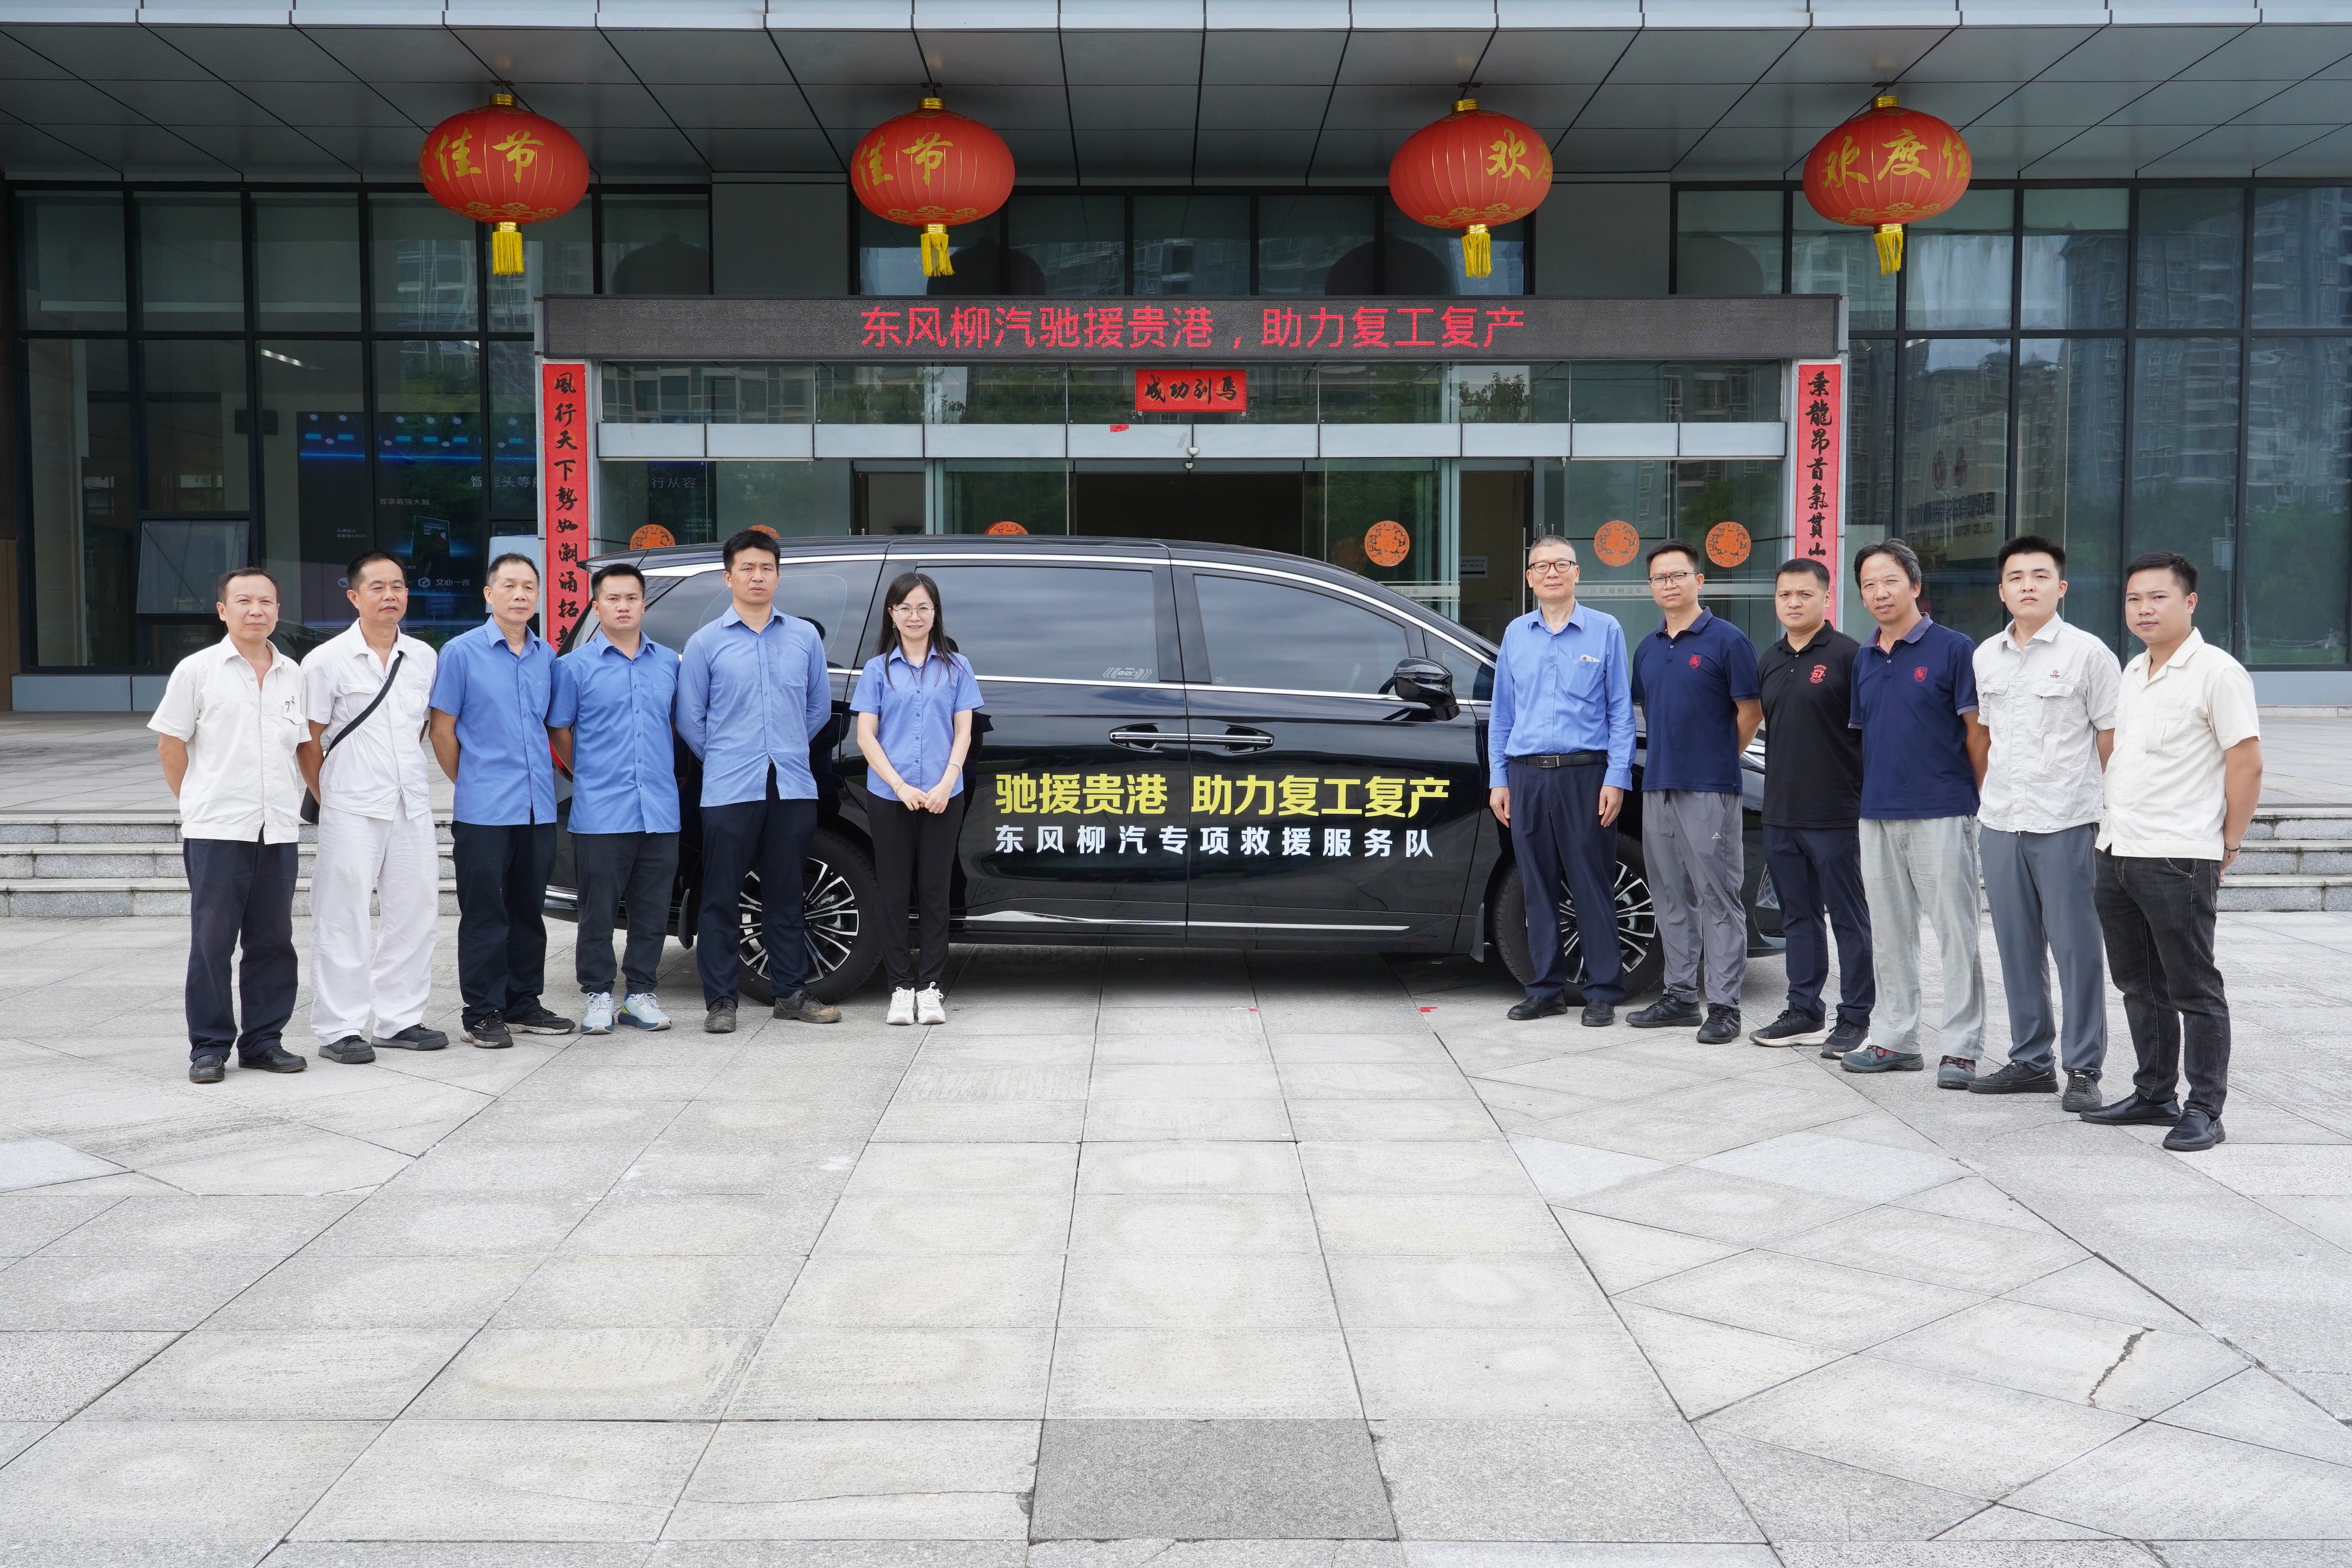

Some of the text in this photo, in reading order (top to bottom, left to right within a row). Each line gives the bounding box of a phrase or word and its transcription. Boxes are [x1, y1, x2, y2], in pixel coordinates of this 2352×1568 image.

[862, 306, 1524, 349] 东风柳汽驰援贵港，助力复工复产
[996, 773, 1450, 817] 驰援贵港 助力复工复产
[995, 825, 1434, 858] 东风柳汽专项救援服务队
